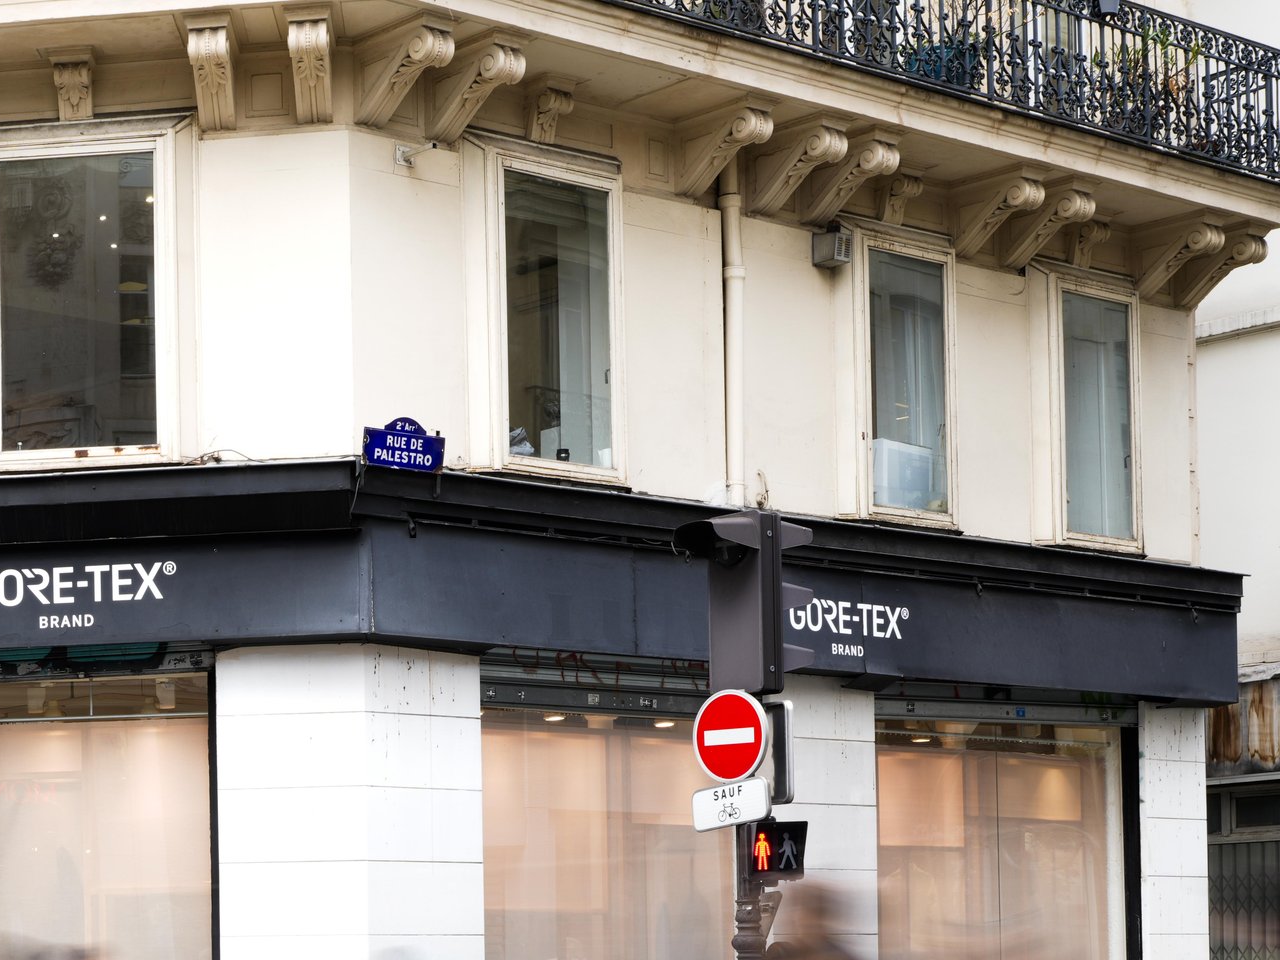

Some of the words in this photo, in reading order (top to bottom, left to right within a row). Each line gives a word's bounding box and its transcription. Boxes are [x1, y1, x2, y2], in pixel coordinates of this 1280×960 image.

[386, 435, 407, 449] RUE
[410, 438, 424, 451] DE
[374, 447, 433, 467] PALESTRO
[38, 613, 95, 629] BRAND
[831, 643, 865, 657] BRAND
[713, 785, 743, 801] SAUF
